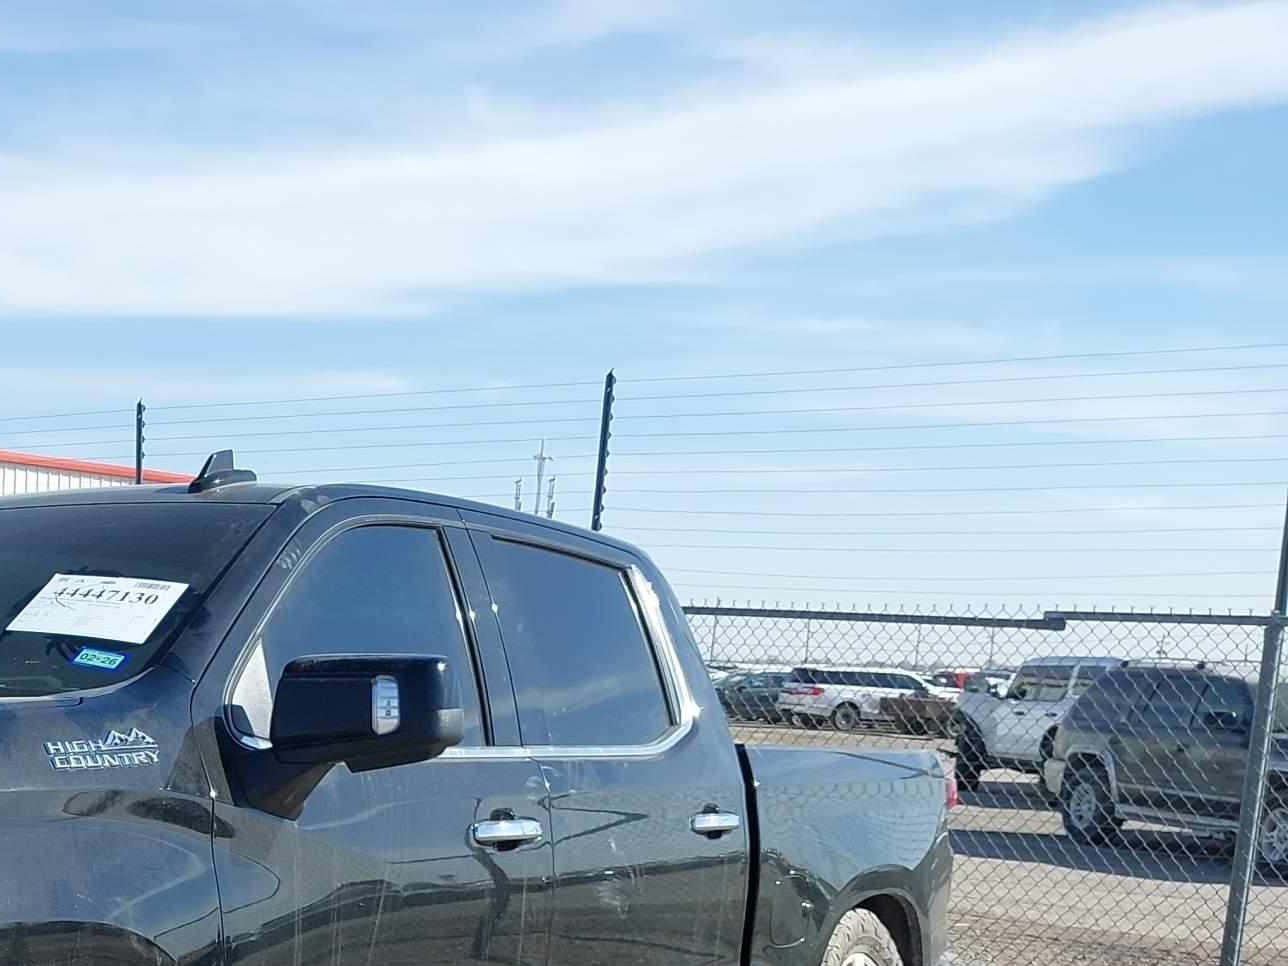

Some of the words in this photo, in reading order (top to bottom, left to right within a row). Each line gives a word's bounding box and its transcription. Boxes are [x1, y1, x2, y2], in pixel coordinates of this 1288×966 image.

[53, 586, 159, 606] 44447130
[43, 739, 104, 755] HIGH
[49, 750, 160, 771] COUNTRY
